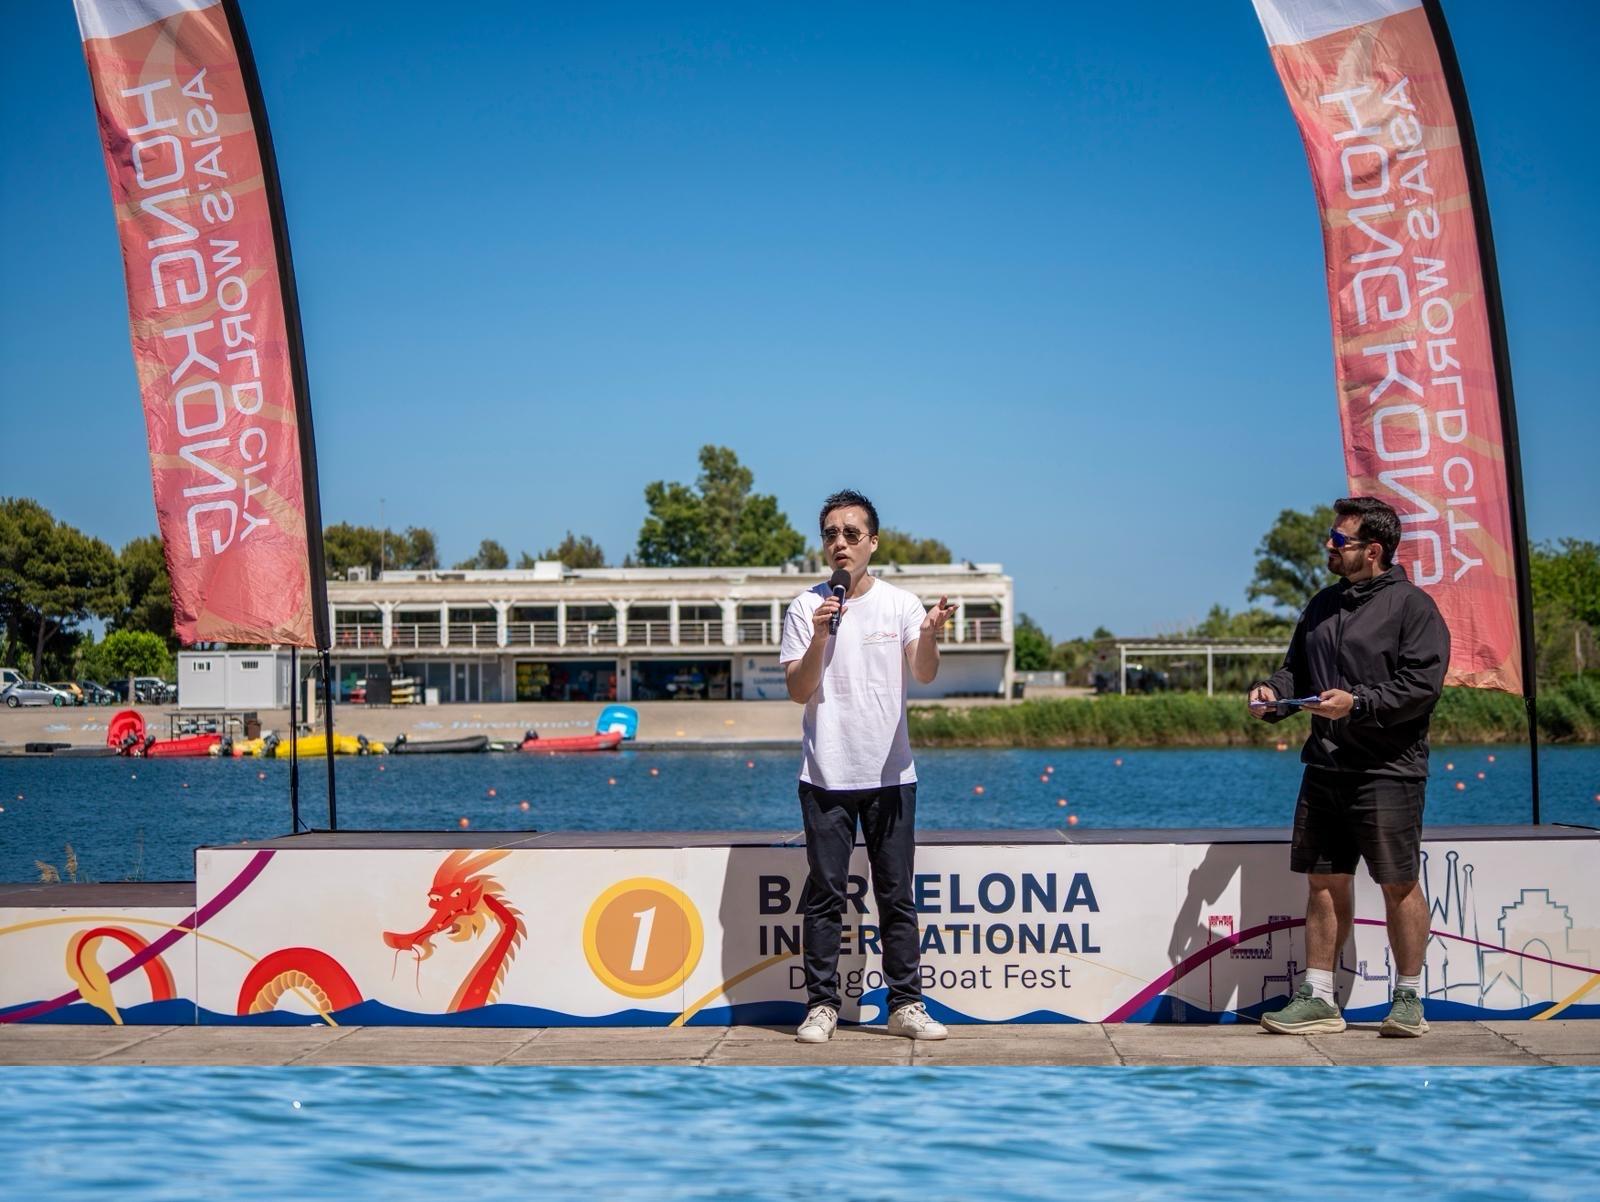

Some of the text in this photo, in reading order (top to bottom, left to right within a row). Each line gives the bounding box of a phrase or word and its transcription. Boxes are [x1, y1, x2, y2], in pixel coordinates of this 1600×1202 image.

[759, 872, 1100, 915] BRELONA
[630, 906, 656, 971] 1
[759, 923, 1101, 956] INERATIONAL
[919, 964, 993, 990] Boat
[1004, 964, 1071, 990] Fest
